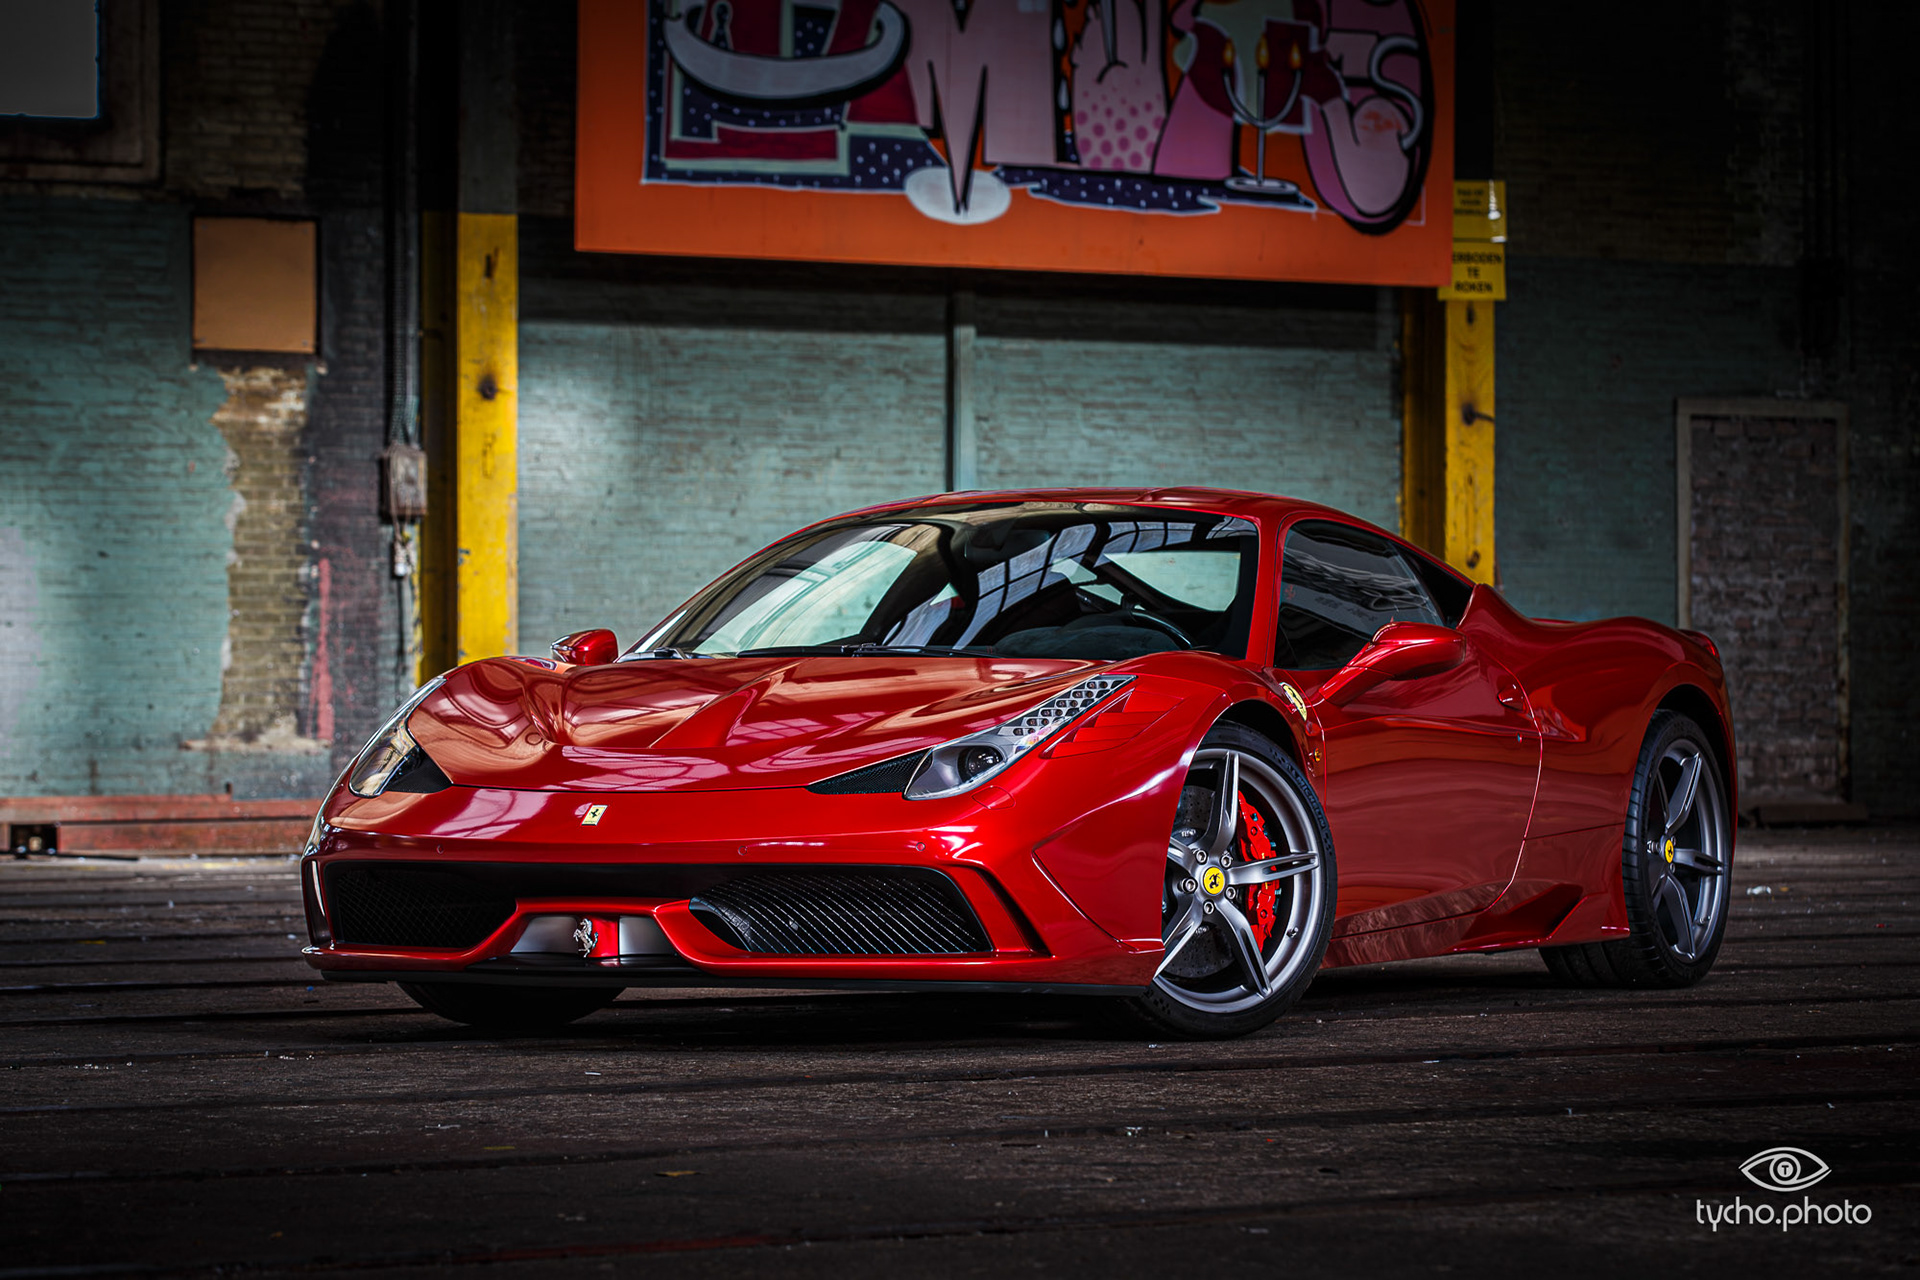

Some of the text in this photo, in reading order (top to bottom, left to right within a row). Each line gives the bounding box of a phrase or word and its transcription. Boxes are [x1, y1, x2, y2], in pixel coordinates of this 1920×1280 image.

[1453, 251, 1502, 264] ERBODEN
[1467, 266, 1480, 279] TE
[1297, 775, 1327, 829] MICHELIN
